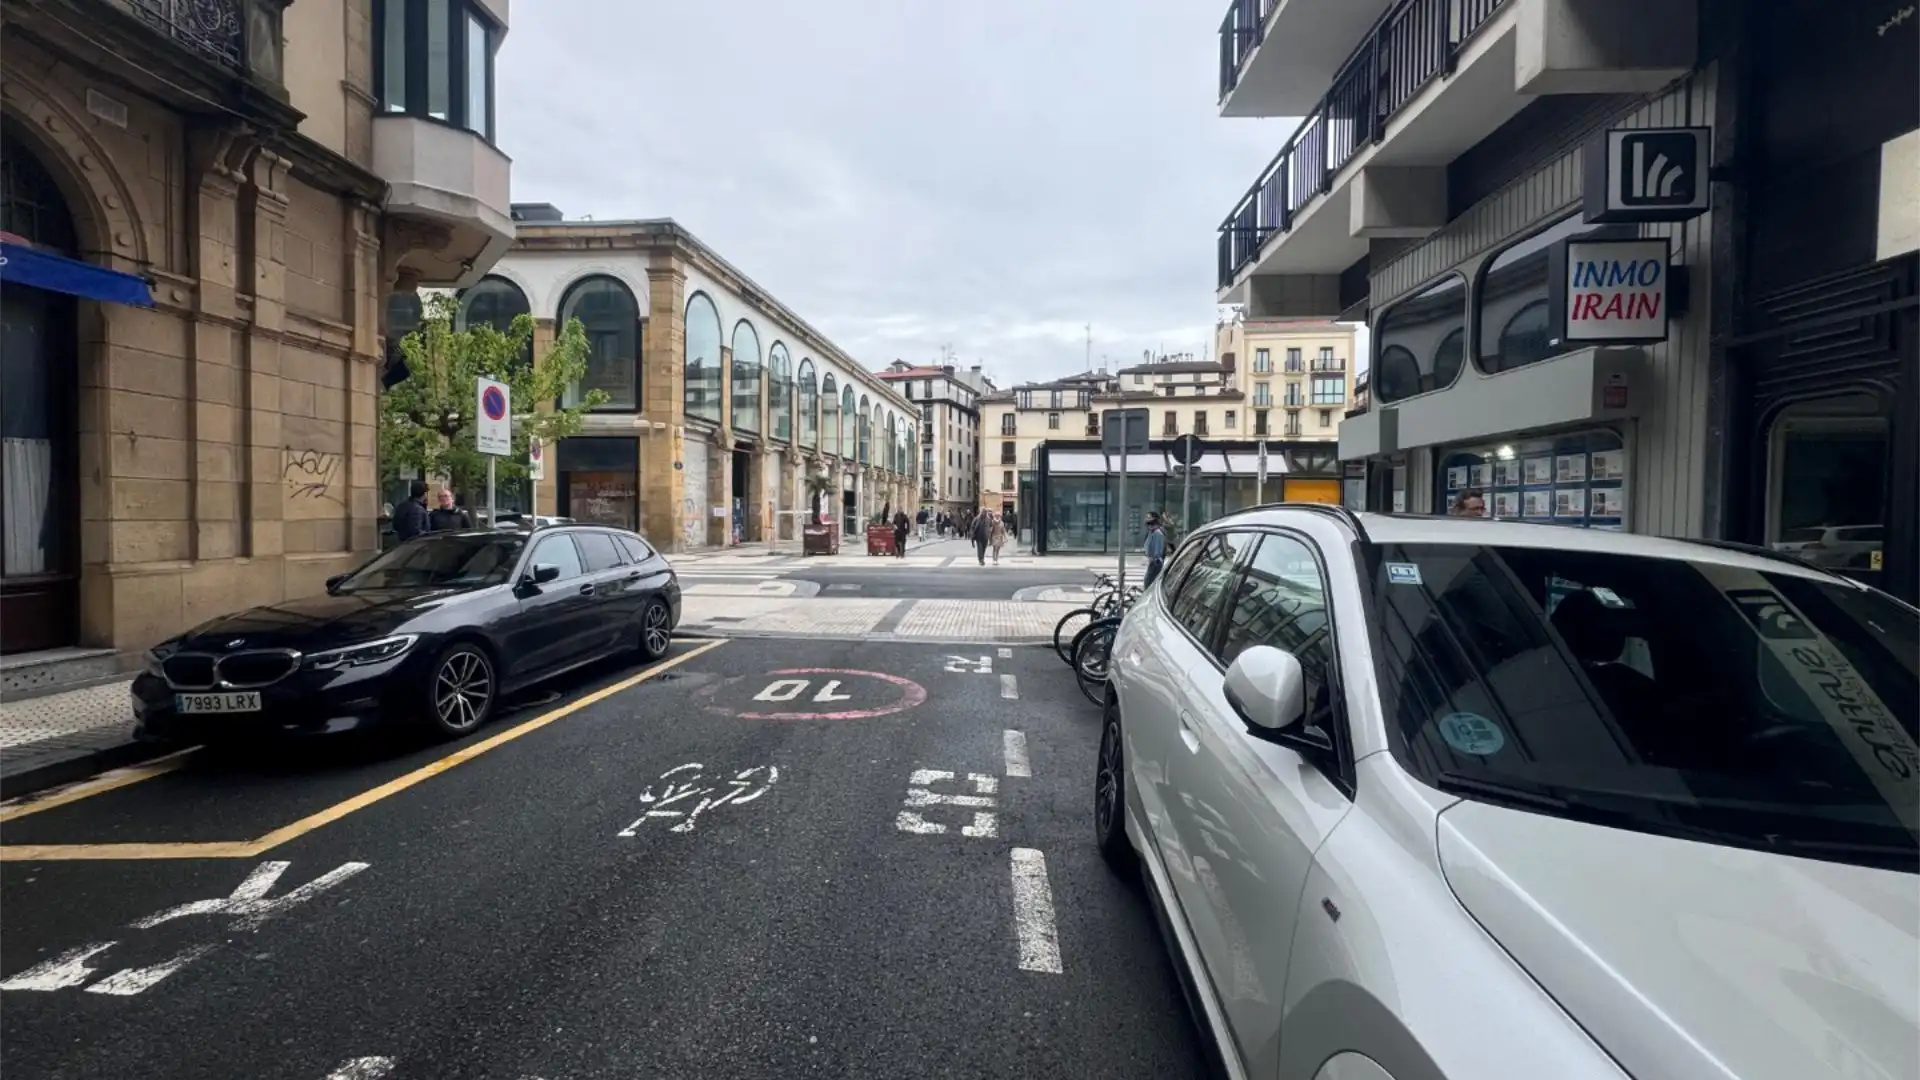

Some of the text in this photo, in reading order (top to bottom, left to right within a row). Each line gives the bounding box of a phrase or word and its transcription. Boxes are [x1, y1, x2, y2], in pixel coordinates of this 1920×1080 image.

[1573, 259, 1661, 288] INMO
[1572, 292, 1660, 320] IRAIN
[184, 695, 222, 711] 7993
[226, 694, 258, 711] LRX
[752, 679, 852, 702] 10
